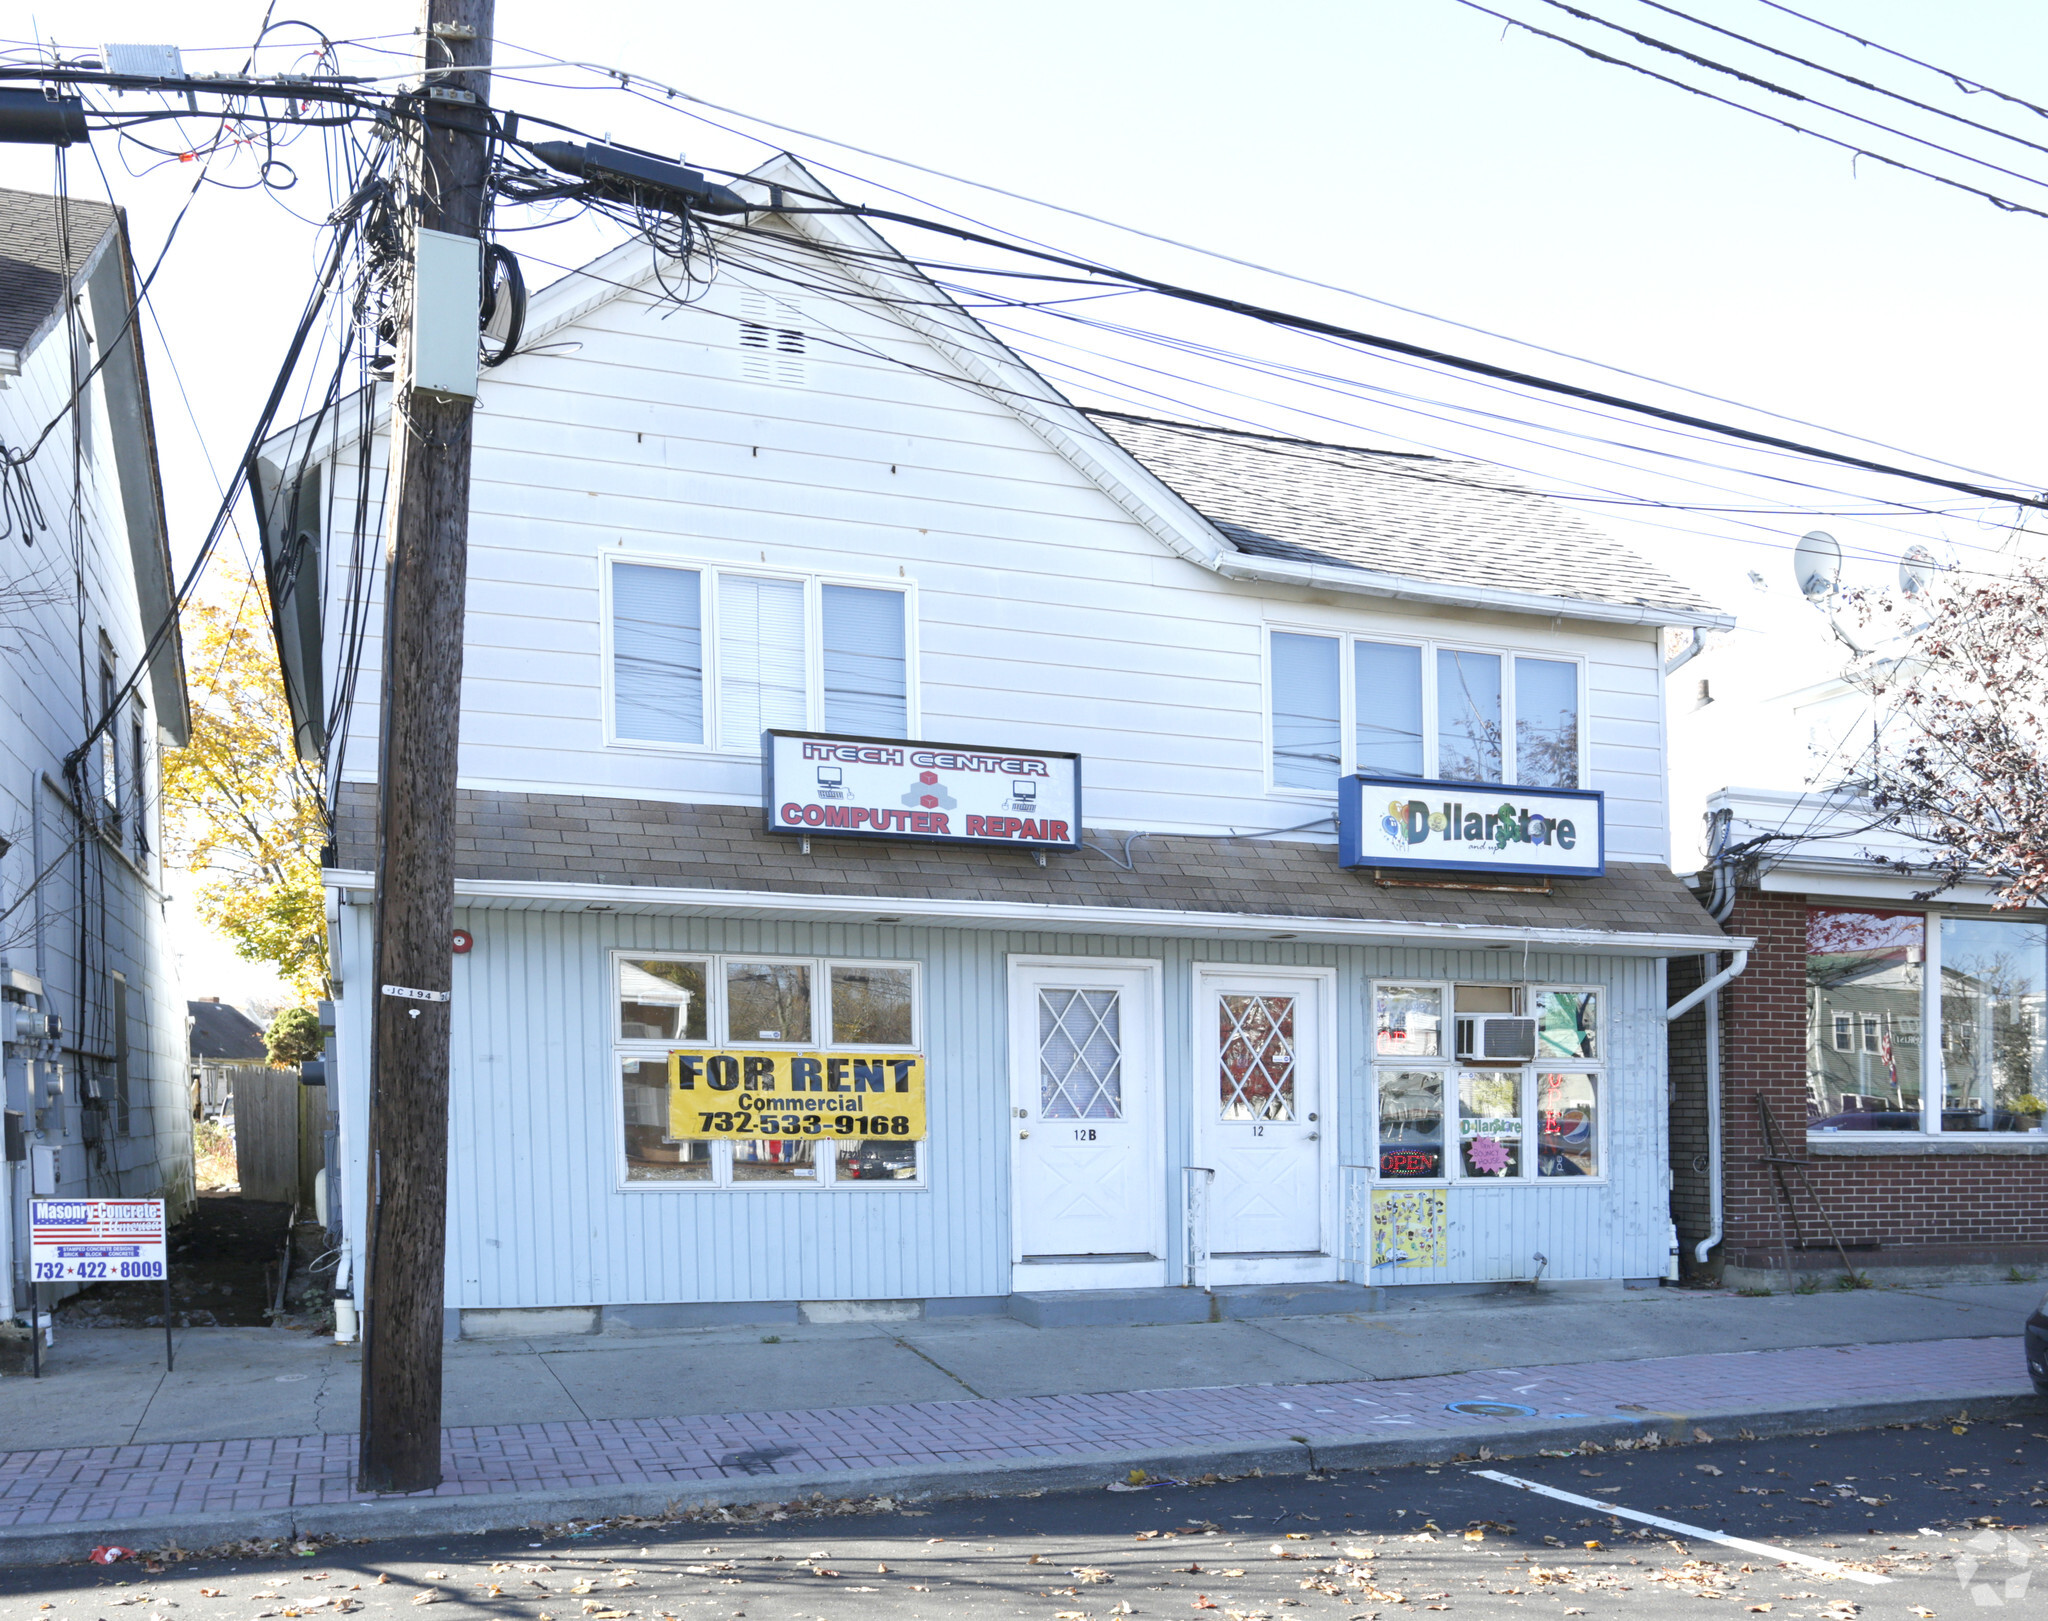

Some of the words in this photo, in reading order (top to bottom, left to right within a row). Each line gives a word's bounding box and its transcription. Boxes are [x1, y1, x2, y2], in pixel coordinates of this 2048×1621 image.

[910, 752, 1050, 777] CENTER
[781, 803, 951, 834] COMPUTER
[966, 815, 1070, 841] REPAIR
[678, 1055, 775, 1091] FOR
[791, 1058, 916, 1093] RENT
[738, 1093, 863, 1112] Commercial
[698, 1111, 910, 1135] 732-533-9168
[1252, 1126, 1264, 1137] 12
[1380, 1155, 1433, 1170] OPEN
[36, 1203, 94, 1220] Masonry
[98, 1202, 157, 1218] Concrete
[35, 1263, 64, 1279] 732
[77, 1262, 107, 1278] 422
[120, 1261, 162, 1278] 8009
